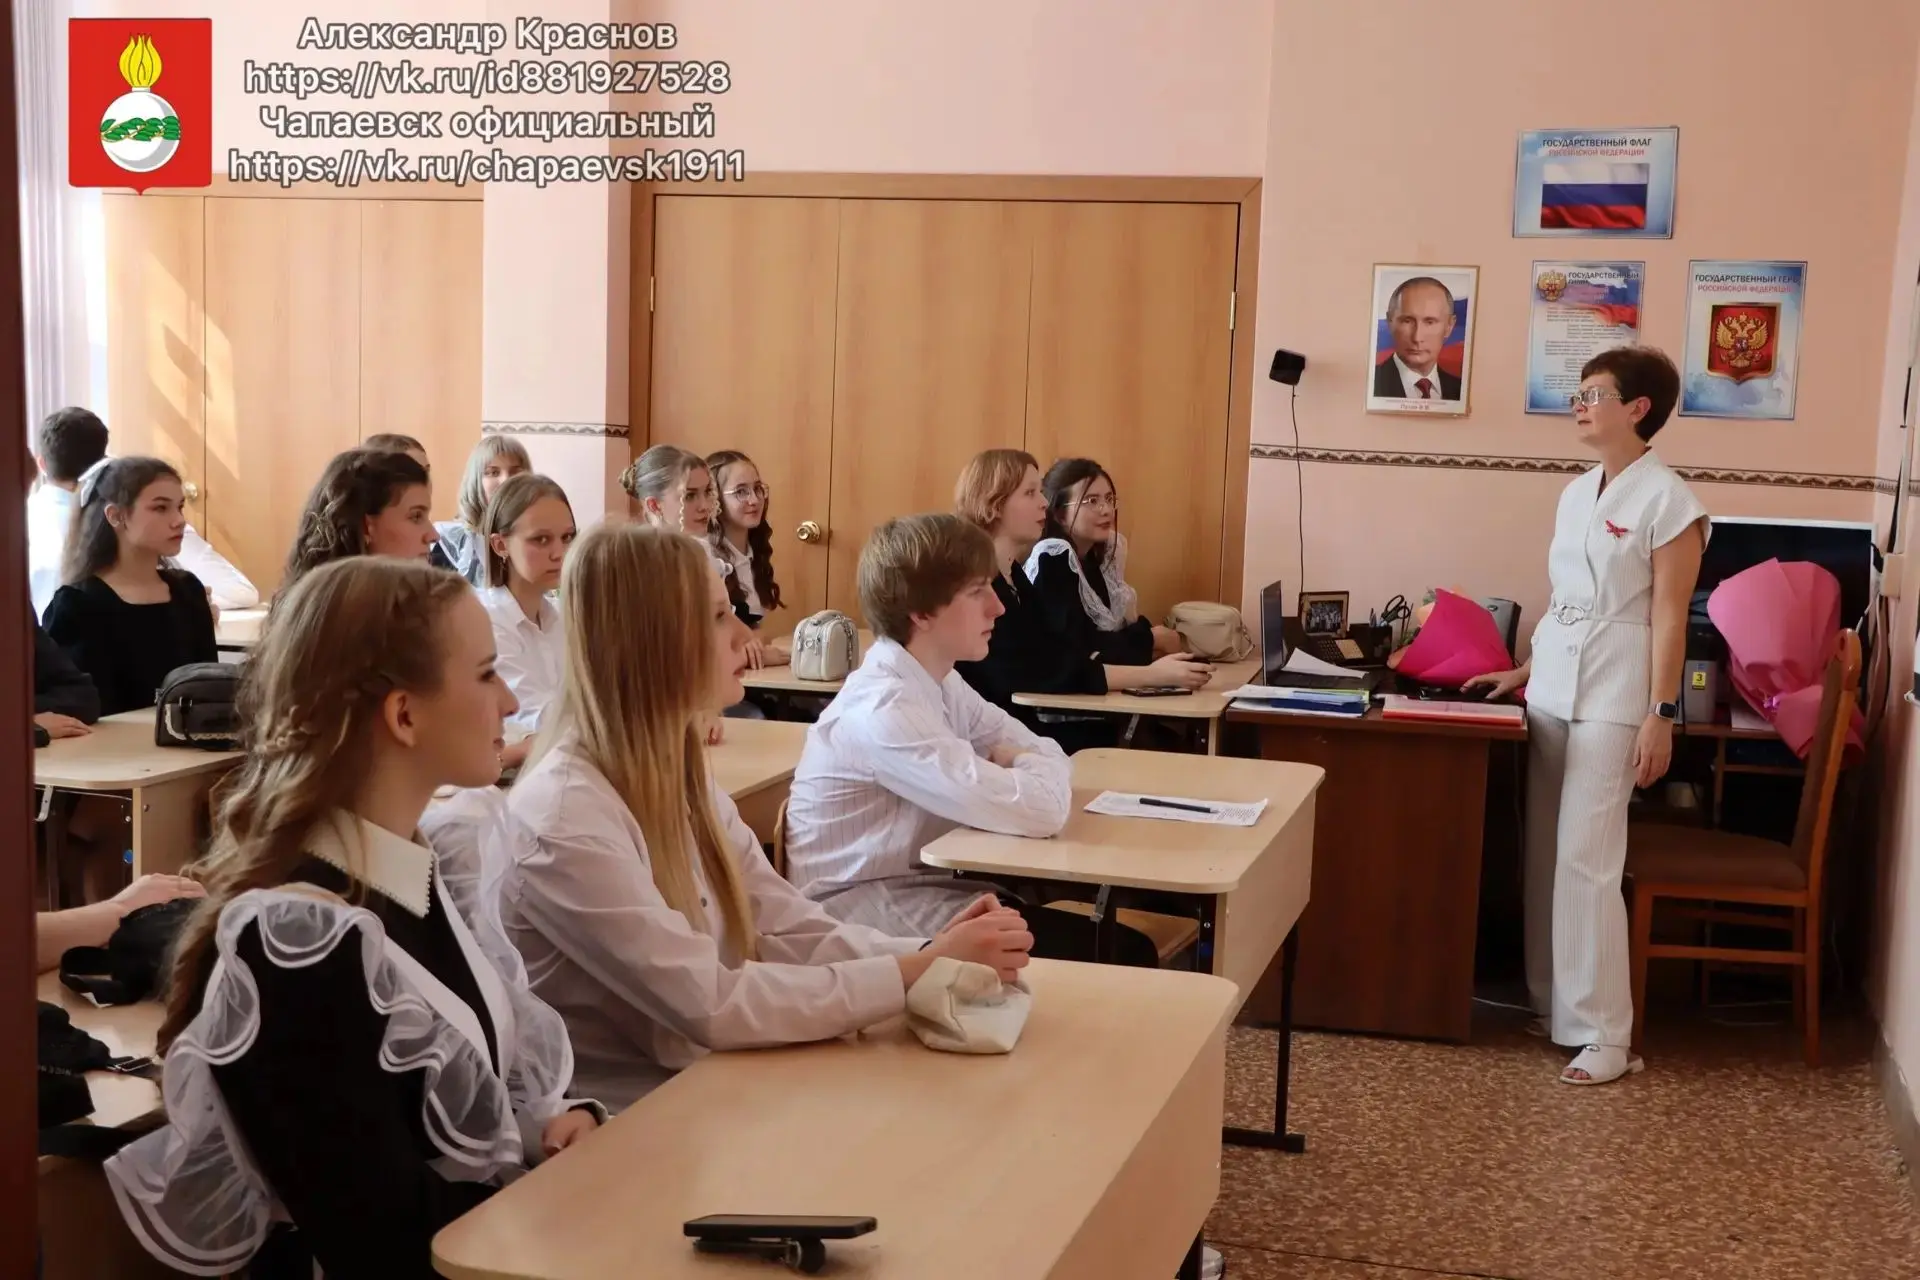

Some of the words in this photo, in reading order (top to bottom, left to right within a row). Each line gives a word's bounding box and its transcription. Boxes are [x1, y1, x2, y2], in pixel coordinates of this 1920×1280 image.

[1542, 137, 1627, 148] ГОСУДАРСТВЕННЫЙ
[1629, 138, 1652, 147] ФЛАГ
[1695, 274, 1776, 284] ГОСУДАРСТВЕННЫЙ
[1696, 673, 1703, 681] 3
